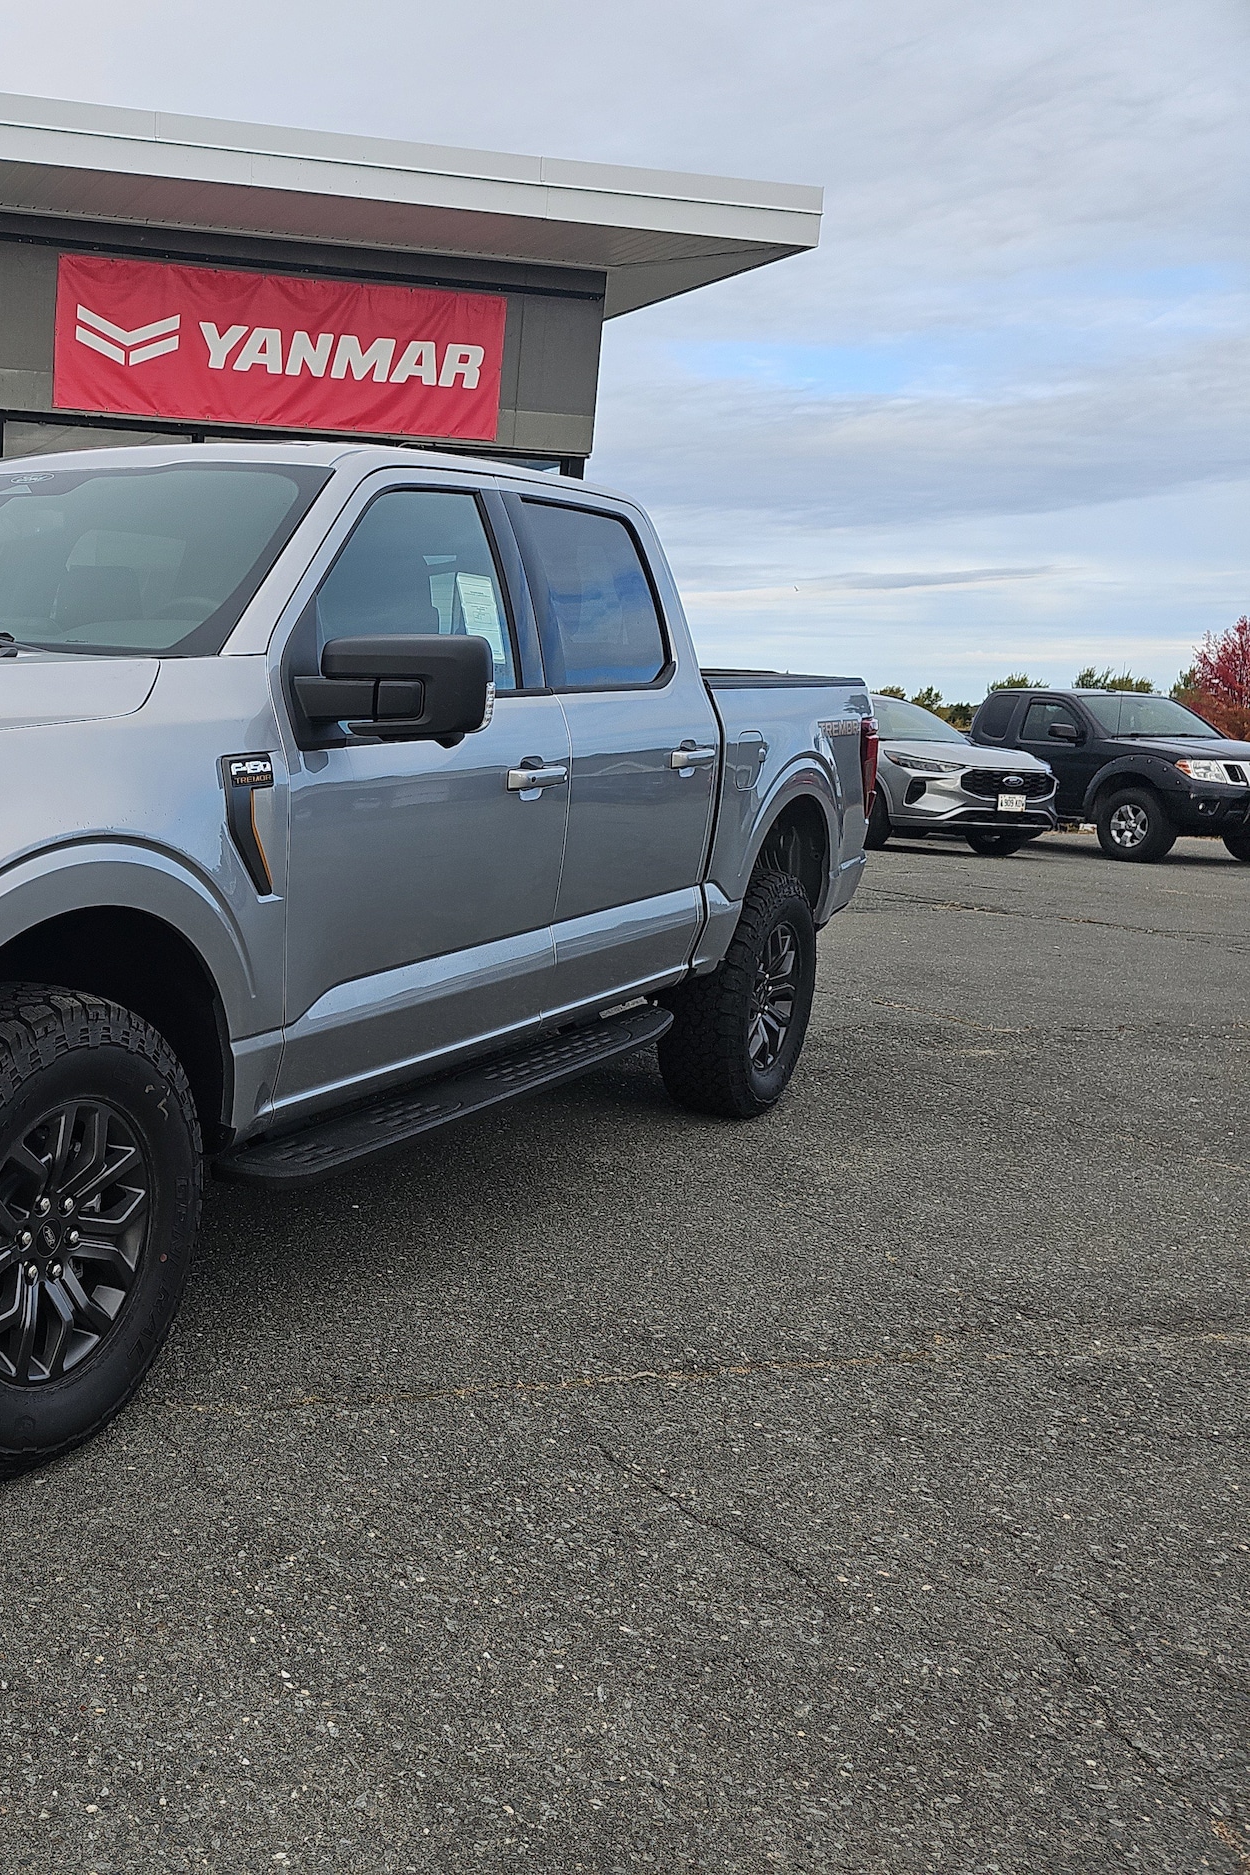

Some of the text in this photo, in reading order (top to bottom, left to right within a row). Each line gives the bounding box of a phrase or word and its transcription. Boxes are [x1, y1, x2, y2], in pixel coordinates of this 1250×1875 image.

[199, 321, 485, 389] YANMAR
[819, 721, 860, 737] TREMOR
[231, 761, 271, 775] F-150
[235, 774, 271, 784] TREMOR
